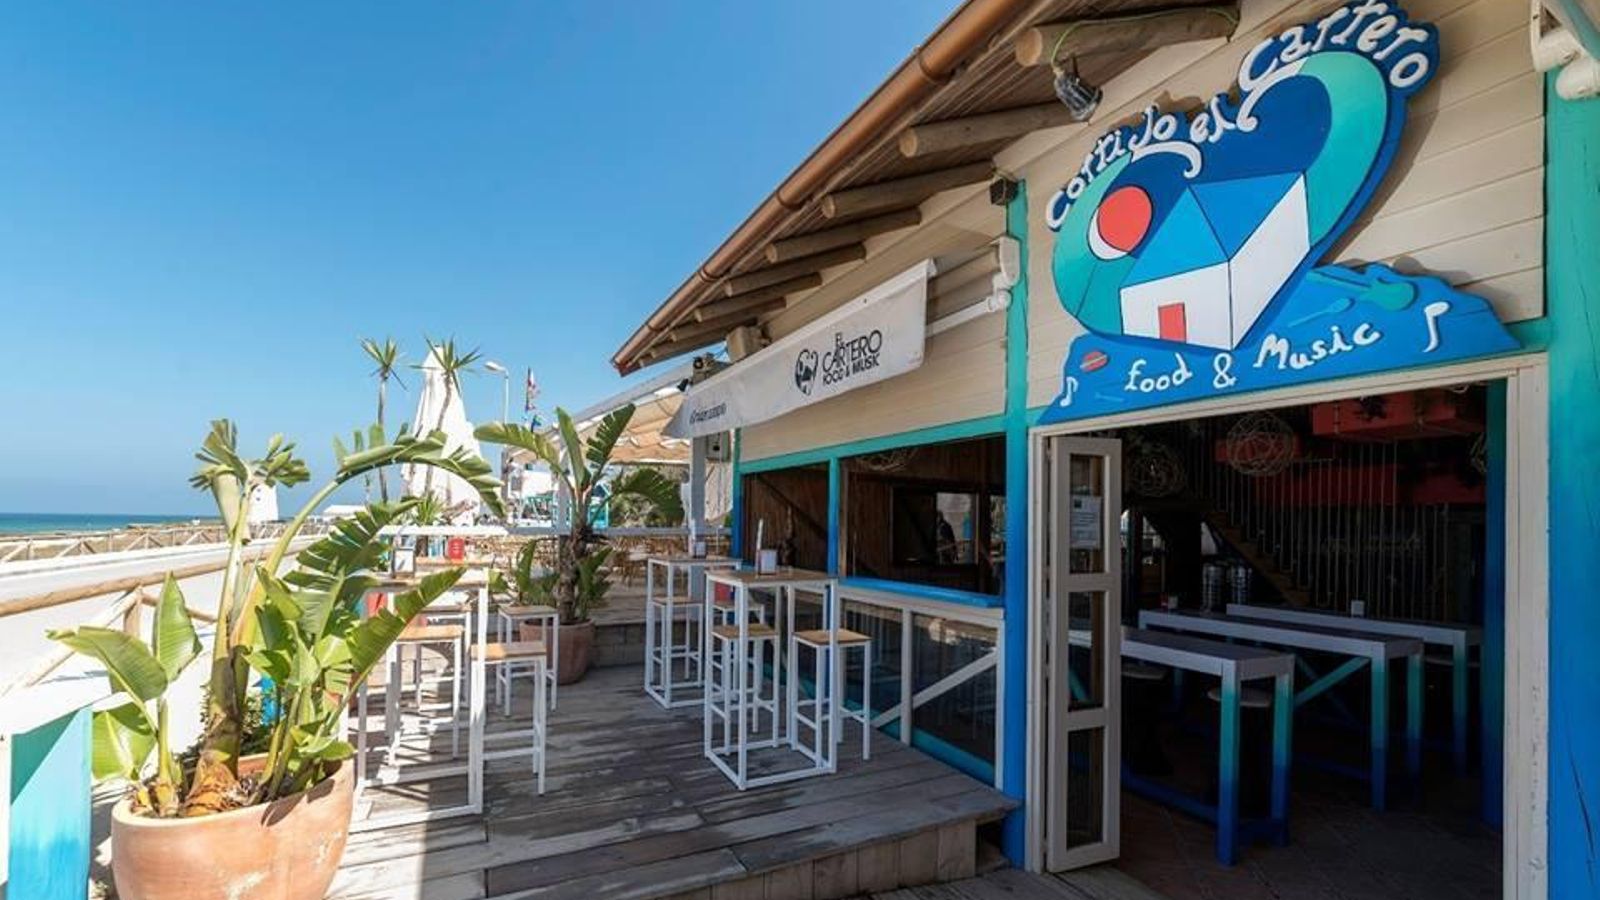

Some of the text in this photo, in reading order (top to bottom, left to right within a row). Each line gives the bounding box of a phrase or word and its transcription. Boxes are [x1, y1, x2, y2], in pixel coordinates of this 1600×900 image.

[1237, 0, 1429, 95] Cartero
[822, 330, 882, 373] CARTERO
[852, 352, 881, 375] MUSIC
[1213, 352, 1236, 389] &
[1253, 323, 1381, 369] Music
